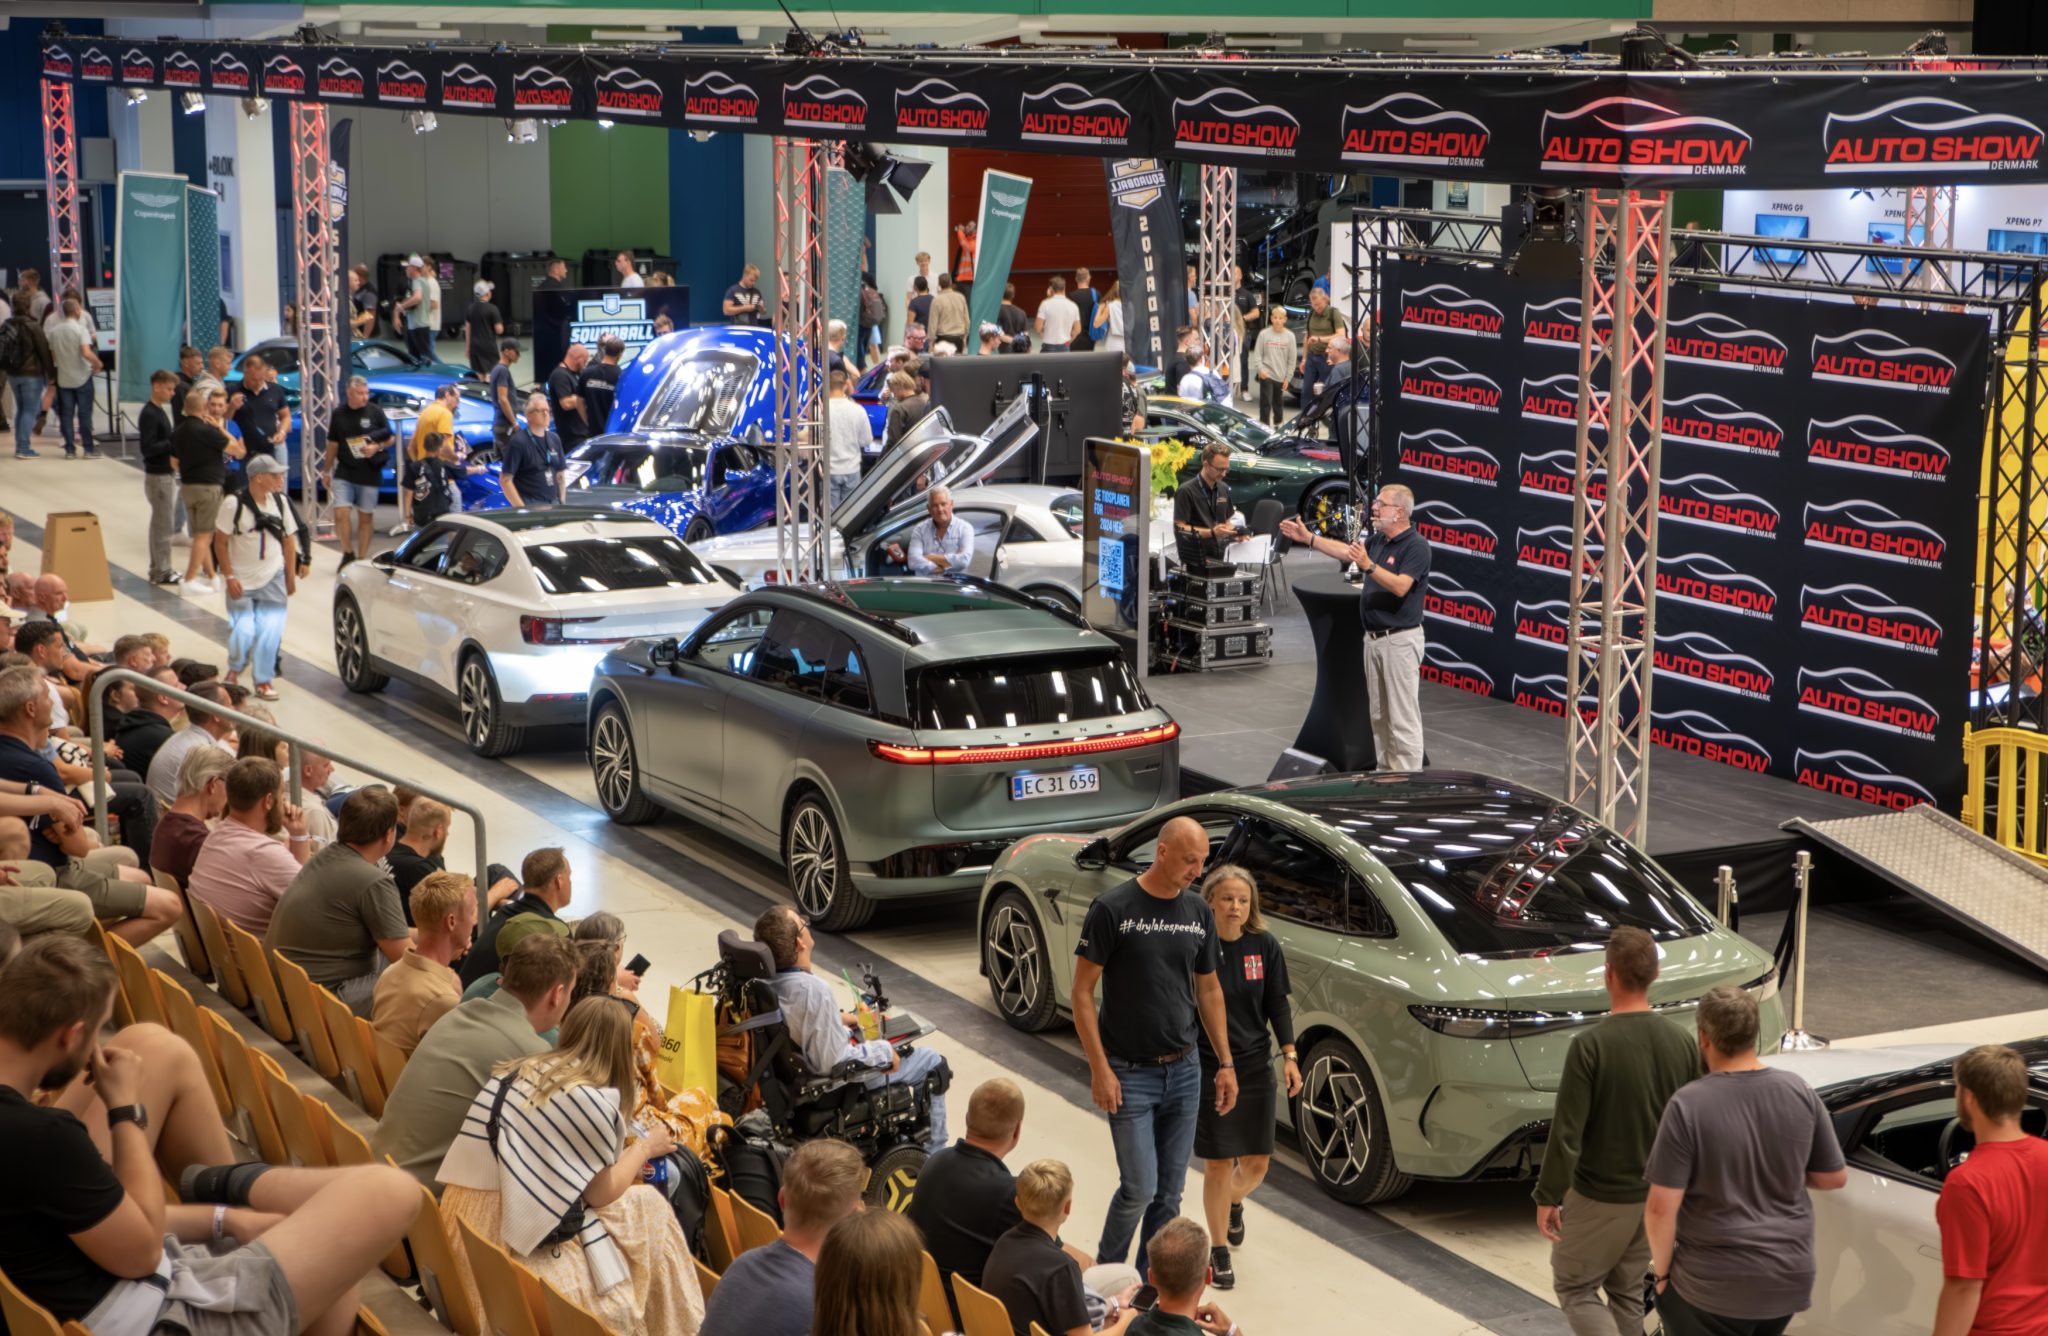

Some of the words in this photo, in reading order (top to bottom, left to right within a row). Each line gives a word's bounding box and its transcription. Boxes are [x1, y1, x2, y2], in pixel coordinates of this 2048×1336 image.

[320, 78, 339, 92] AUTO
[340, 79, 363, 94] SHOW
[380, 82, 400, 96] AUTO
[401, 83, 426, 97] SHOW
[444, 86, 467, 101] AUTO
[468, 87, 496, 102] SHOW
[515, 90, 540, 104] AUTO
[541, 90, 571, 104] SHOW
[598, 91, 627, 108] AUTO
[629, 93, 661, 110] SHOW
[686, 97, 718, 114] AUTO
[720, 99, 758, 117] SHOW
[785, 102, 821, 121] AUTO
[822, 104, 866, 123] SHOW
[897, 108, 939, 128] AUTO
[940, 109, 988, 129] SHOW
[1023, 113, 1071, 134] AUTO
[1072, 115, 1129, 137] SHOW
[1175, 120, 1230, 144] AUTO
[1232, 123, 1297, 148] SHOW
[1101, 137, 1128, 146] DENMARK
[1343, 129, 1407, 154] AUTO
[1408, 131, 1487, 157] SHOW
[1543, 136, 1622, 164] AUTO
[1628, 138, 1748, 166] SHOW
[1827, 137, 1927, 163] AUTO
[1930, 135, 2041, 162] SHOW
[1266, 148, 1296, 158] DENMARK
[1450, 156, 1485, 167] DENMARK
[1694, 164, 1746, 175] DENMARK
[1990, 160, 2039, 170] DENMARK
[134, 210, 176, 220] Copenhagen
[992, 208, 1022, 220] Copenhagen
[1772, 203, 1792, 212] XPENG
[1795, 204, 1804, 212] G9
[2006, 217, 2031, 226] XPENG
[2032, 218, 2042, 228] P7
[1402, 306, 1447, 326] AUTO
[1449, 310, 1502, 332] SHOW
[1477, 331, 1502, 340] DENMARK
[1525, 320, 1575, 343] AUTO
[1665, 336, 1718, 359] AUTO
[1719, 342, 1786, 368] SHOW
[1754, 364, 1784, 374] DENMARK
[1813, 354, 1876, 378] AUTO
[1878, 361, 1954, 387] SHOW
[1401, 377, 1446, 399] AUTO
[1447, 384, 1501, 407] SHOW
[1918, 384, 1950, 394] DENMARK
[1475, 404, 1500, 414] DENMARK
[1523, 395, 1573, 418] AUTO
[1661, 415, 1714, 441] AUTO
[1715, 423, 1781, 450] SHOW
[1750, 447, 1780, 458] DENMARK
[1809, 438, 1872, 464] AUTO
[1873, 447, 1948, 474] SHOW
[1400, 448, 1444, 471] AUTO
[1445, 456, 1498, 481] SHOW
[1473, 477, 1498, 488] DENMARK
[1521, 470, 1570, 494] AUTO
[1913, 470, 1946, 482] DENMARK
[1658, 495, 1711, 520] AUTO
[1711, 504, 1777, 532] SHOW
[1444, 528, 1496, 554] SHOW
[1747, 528, 1776, 540] DENMARK
[1806, 521, 1868, 548] AUTO
[1869, 532, 1943, 561] SHOW
[1471, 550, 1496, 560] DENMARK
[1518, 544, 1567, 569] AUTO
[1909, 557, 1942, 570] DENMARK
[1655, 573, 1707, 599] AUTO
[1708, 584, 1775, 613] SHOW
[1423, 595, 1442, 613] TO
[1442, 599, 1494, 626] SHOW
[1744, 608, 1774, 621] DENMARK
[1470, 622, 1494, 633] DENMARK
[1516, 618, 1565, 644] AUTO
[1802, 604, 1864, 633] AUTO
[1866, 616, 1940, 647] SHOW
[1905, 642, 1939, 656] DENMARK
[1652, 650, 1704, 678] AUTO
[1705, 663, 1772, 694] SHOW
[1441, 671, 1492, 697] SHOW
[1514, 692, 1563, 717] AUTO
[1741, 688, 1771, 702] DENMARK
[1799, 686, 1861, 716] AUTO
[1863, 700, 1937, 733] SHOW
[1902, 727, 1936, 742] DENMARK
[1649, 727, 1702, 756] AUTO
[1703, 742, 1769, 773] SHOW
[1024, 778, 1044, 794] EC
[1048, 777, 1063, 792] 31
[1070, 774, 1096, 790] 659
[1797, 768, 1858, 798] AUTO
[1861, 784, 1934, 811] SHO
